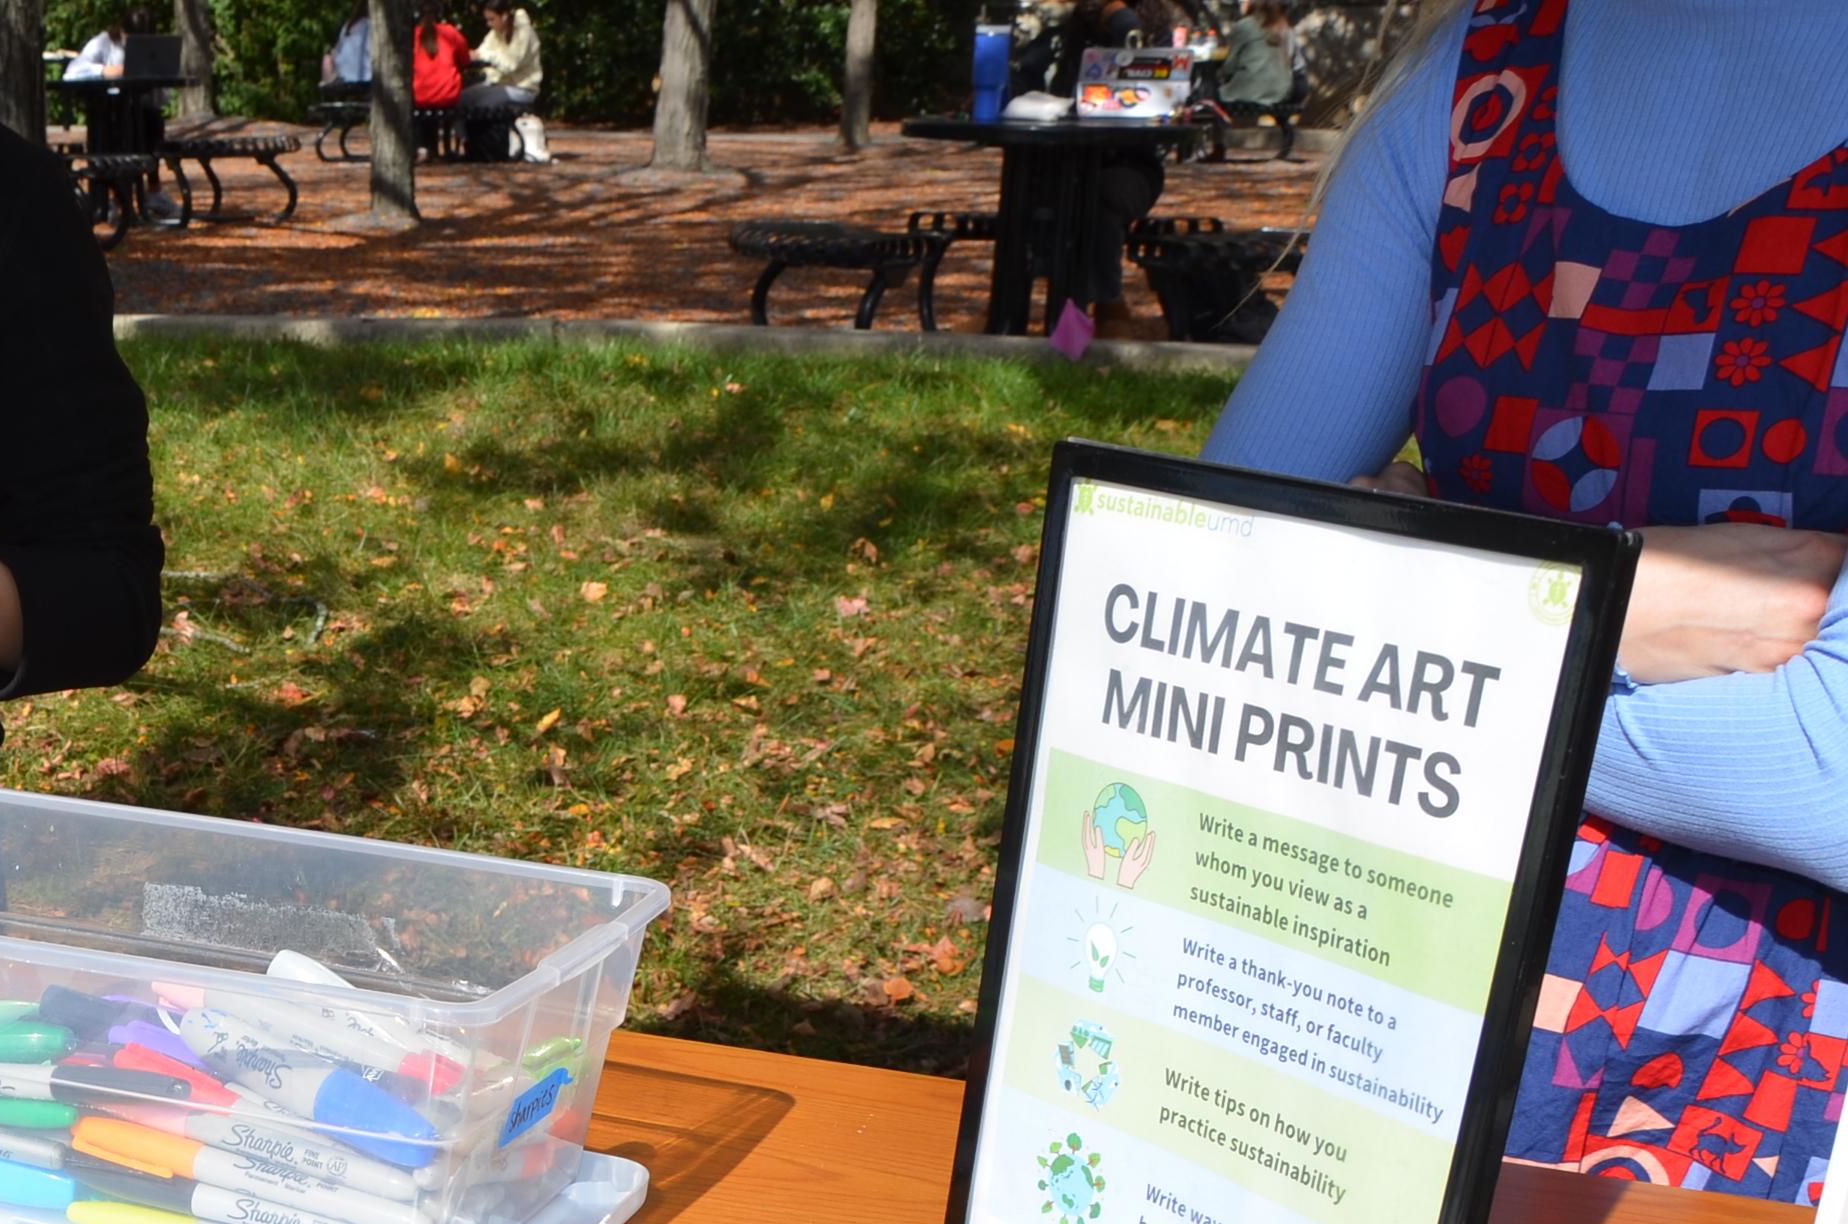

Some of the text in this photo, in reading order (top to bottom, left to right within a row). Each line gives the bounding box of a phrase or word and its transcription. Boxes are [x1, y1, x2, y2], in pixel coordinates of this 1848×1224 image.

[1096, 492, 1255, 538] sustainableumd
[1103, 583, 1501, 729] CLIMATE ART
[1102, 669, 1463, 821] MINI PRINTS
[1195, 850, 1368, 920] whom you view as a
[1198, 811, 1454, 908] Write a message to someone
[1190, 884, 1391, 967] sustainable inspiration
[1177, 972, 1384, 1064] professor, staff, or faculty
[1182, 937, 1397, 1031] Write a thank-you note to a
[1173, 1002, 1444, 1126] member engaged in sustainability
[304, 1149, 320, 1160] FINE
[1159, 1105, 1347, 1206] practice sustainability
[1165, 1067, 1348, 1163] Write tips on how you
[303, 1157, 324, 1169] POINT
[1146, 1183, 1187, 1217] Write
